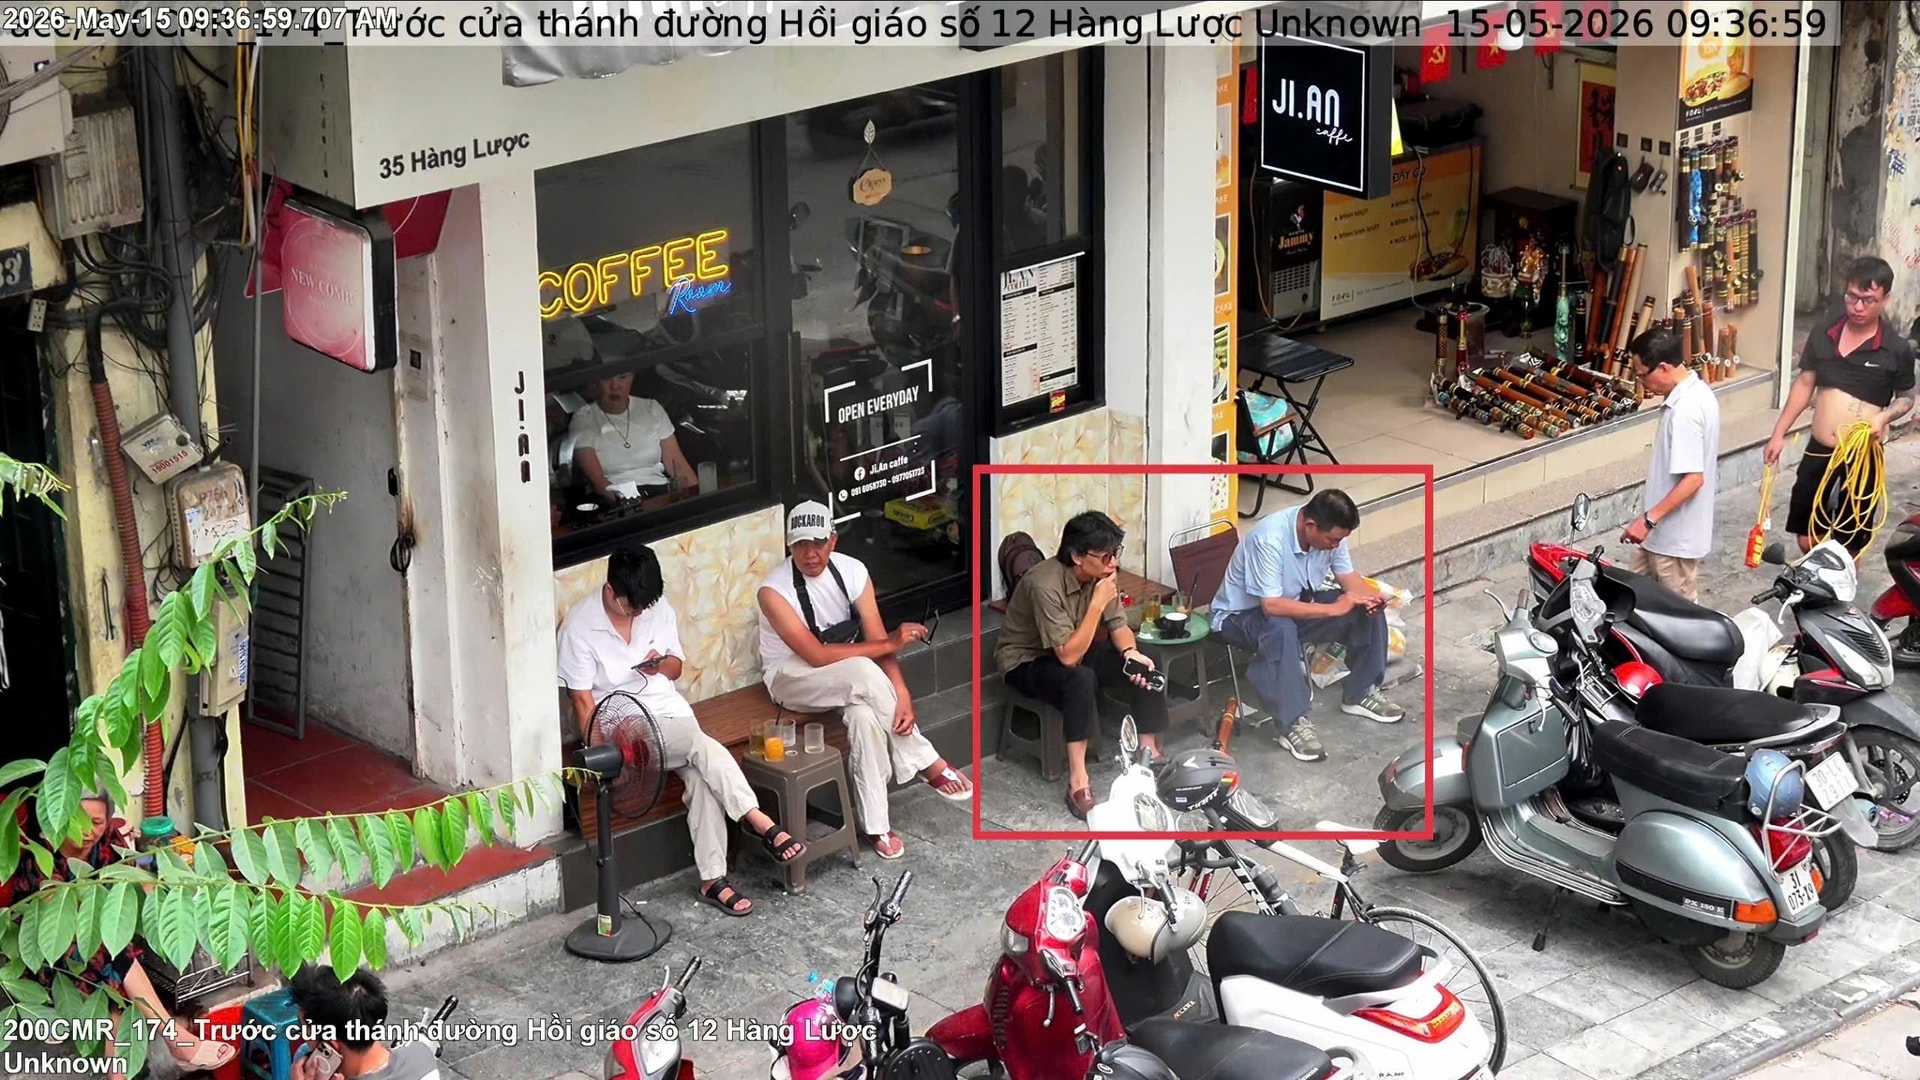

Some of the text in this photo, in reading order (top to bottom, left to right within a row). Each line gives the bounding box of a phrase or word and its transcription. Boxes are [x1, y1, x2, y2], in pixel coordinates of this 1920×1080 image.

[1272, 78, 1340, 128] JI.AN
[379, 132, 530, 179] 35 Hàng Lược
[1315, 127, 1353, 146] caffe
[291, 267, 315, 288] NEW
[538, 229, 729, 318] COFFEE
[668, 277, 732, 315] Room
[838, 385, 919, 424] OPEN EVERYDAY
[869, 455, 908, 475] Ji.An caffe
